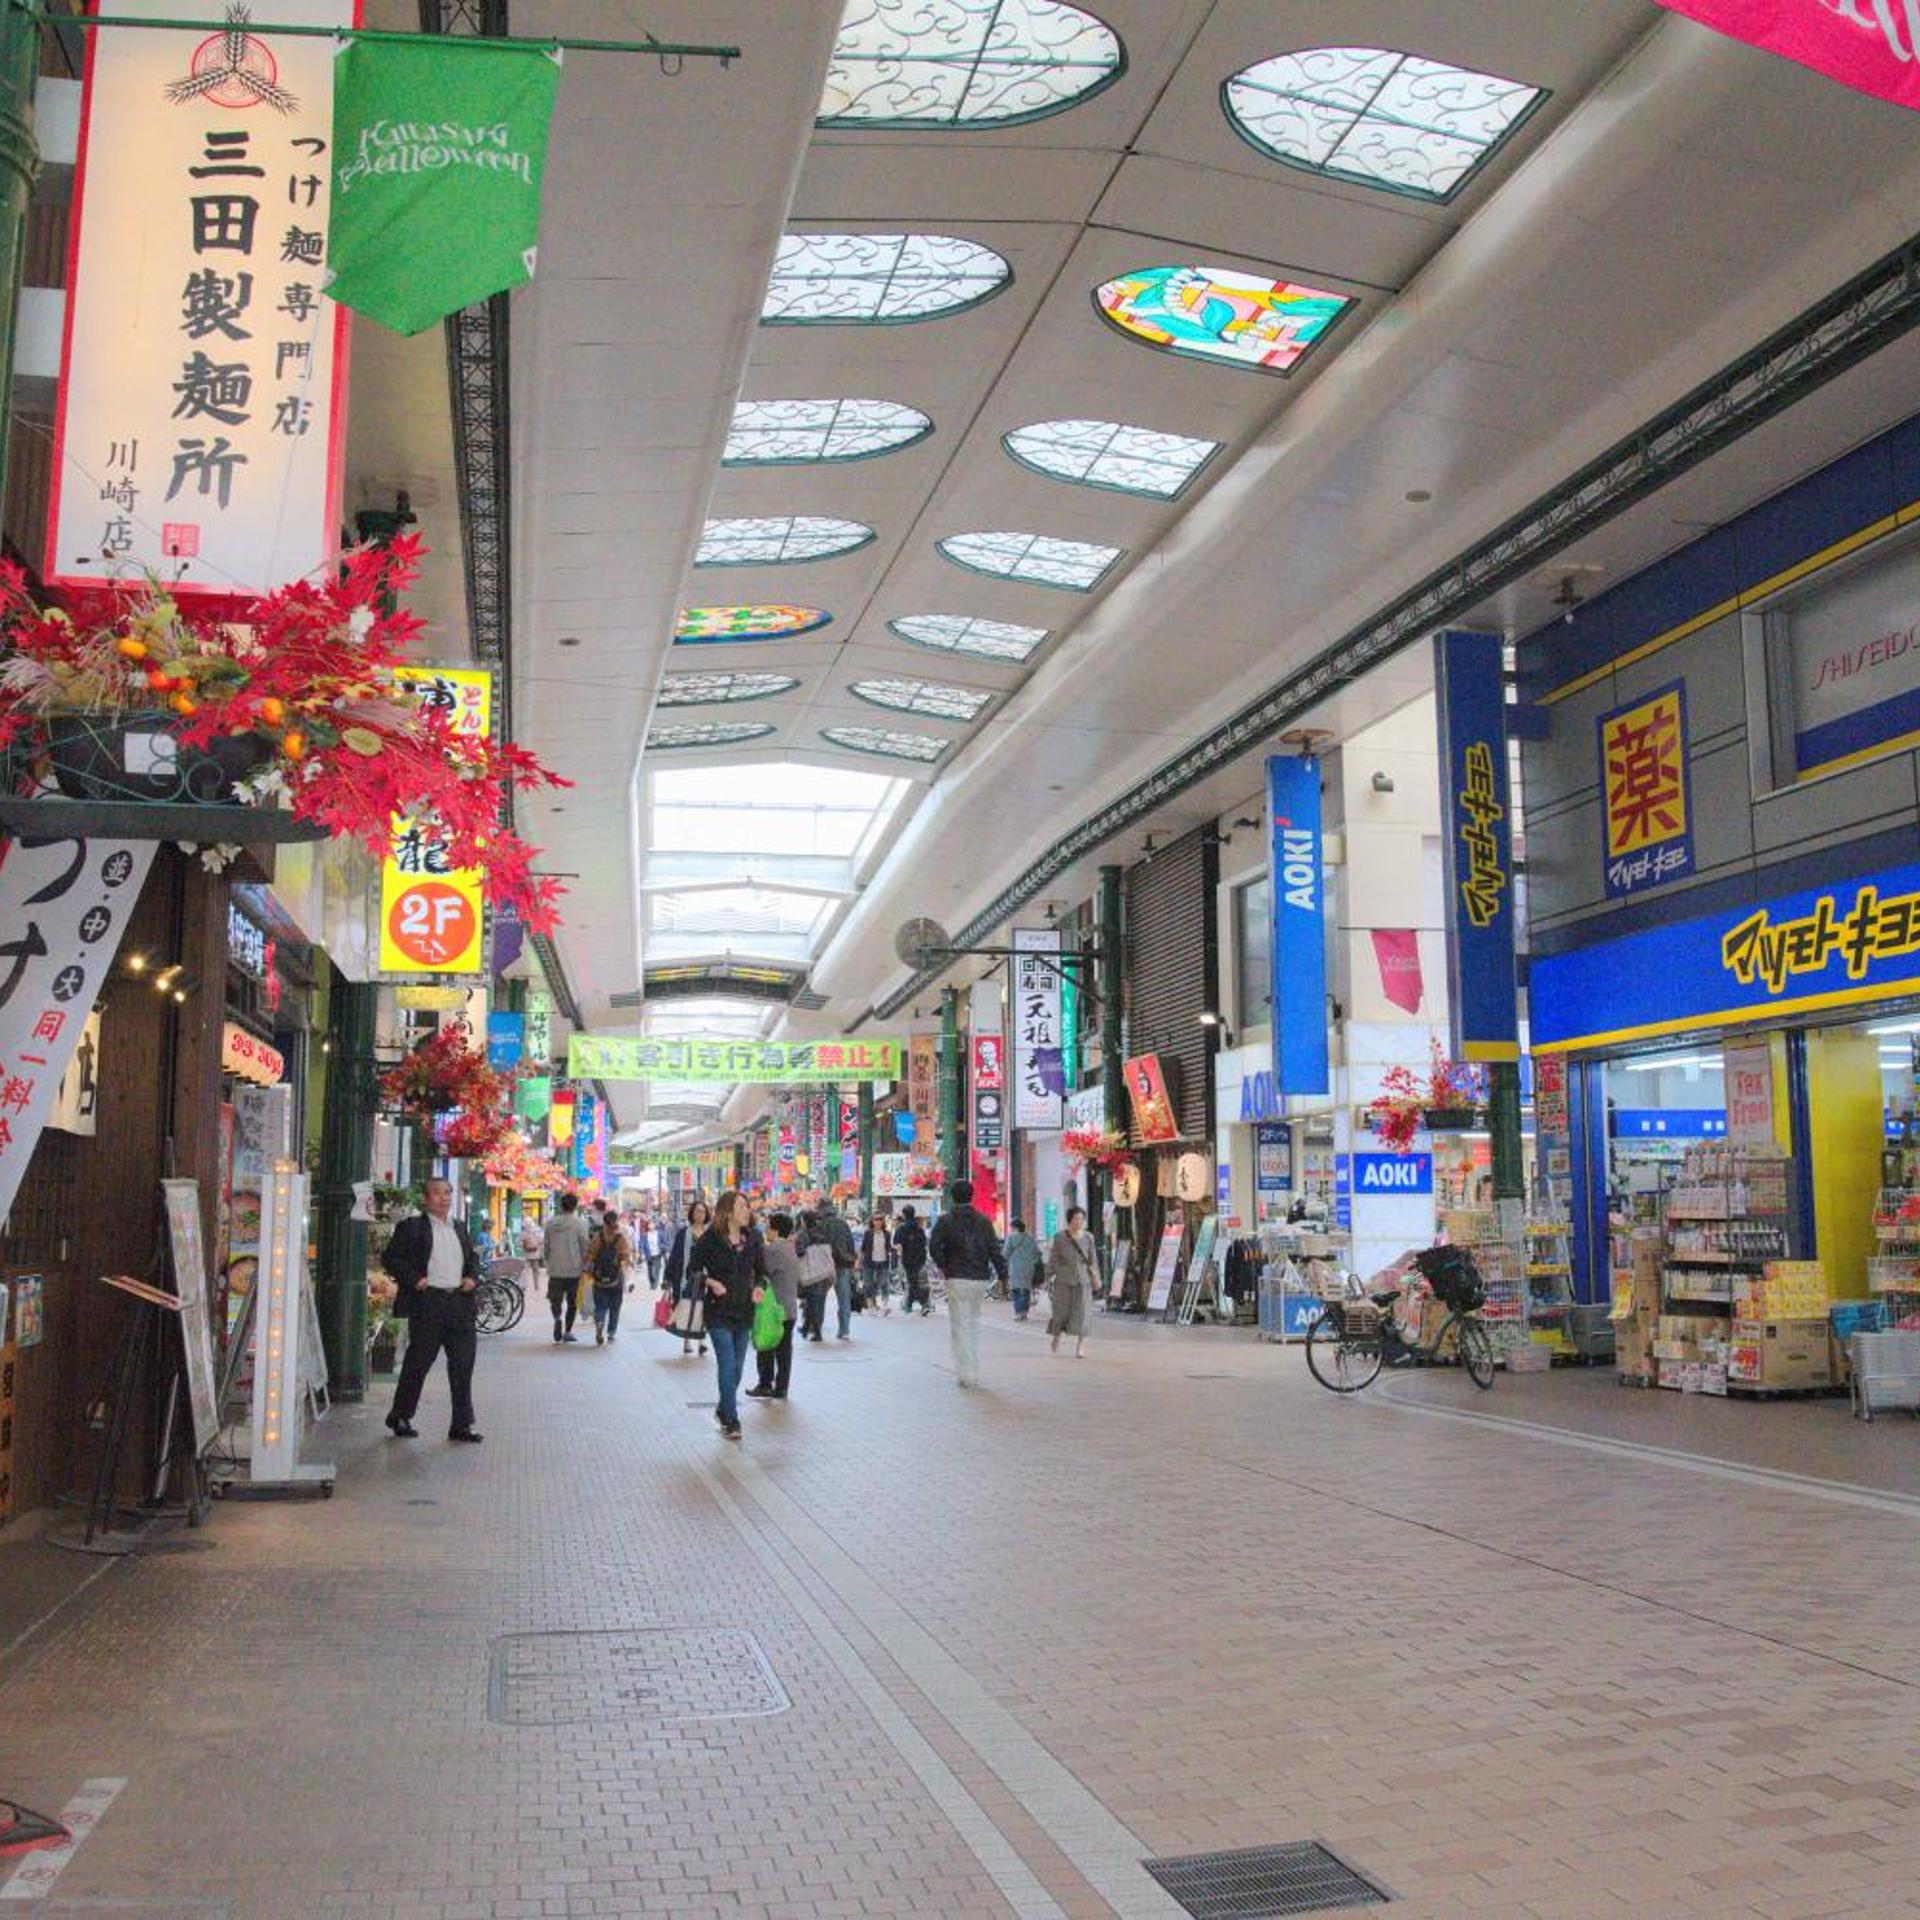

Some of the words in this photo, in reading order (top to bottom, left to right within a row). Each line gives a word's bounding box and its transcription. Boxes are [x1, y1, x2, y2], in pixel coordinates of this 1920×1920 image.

[164, 130, 266, 509] 三田製麺所
[270, 136, 326, 437] つけ麺専門店
[99, 437, 141, 553] 川崎店
[1460, 741, 1504, 926] マツモトキヨシ
[1607, 705, 1680, 849] 薬
[400, 893, 464, 936] 2F
[1283, 828, 1315, 912] AOKI
[1608, 847, 1689, 889] マツモトキヨシ
[1363, 1162, 1418, 1187] AOKI
